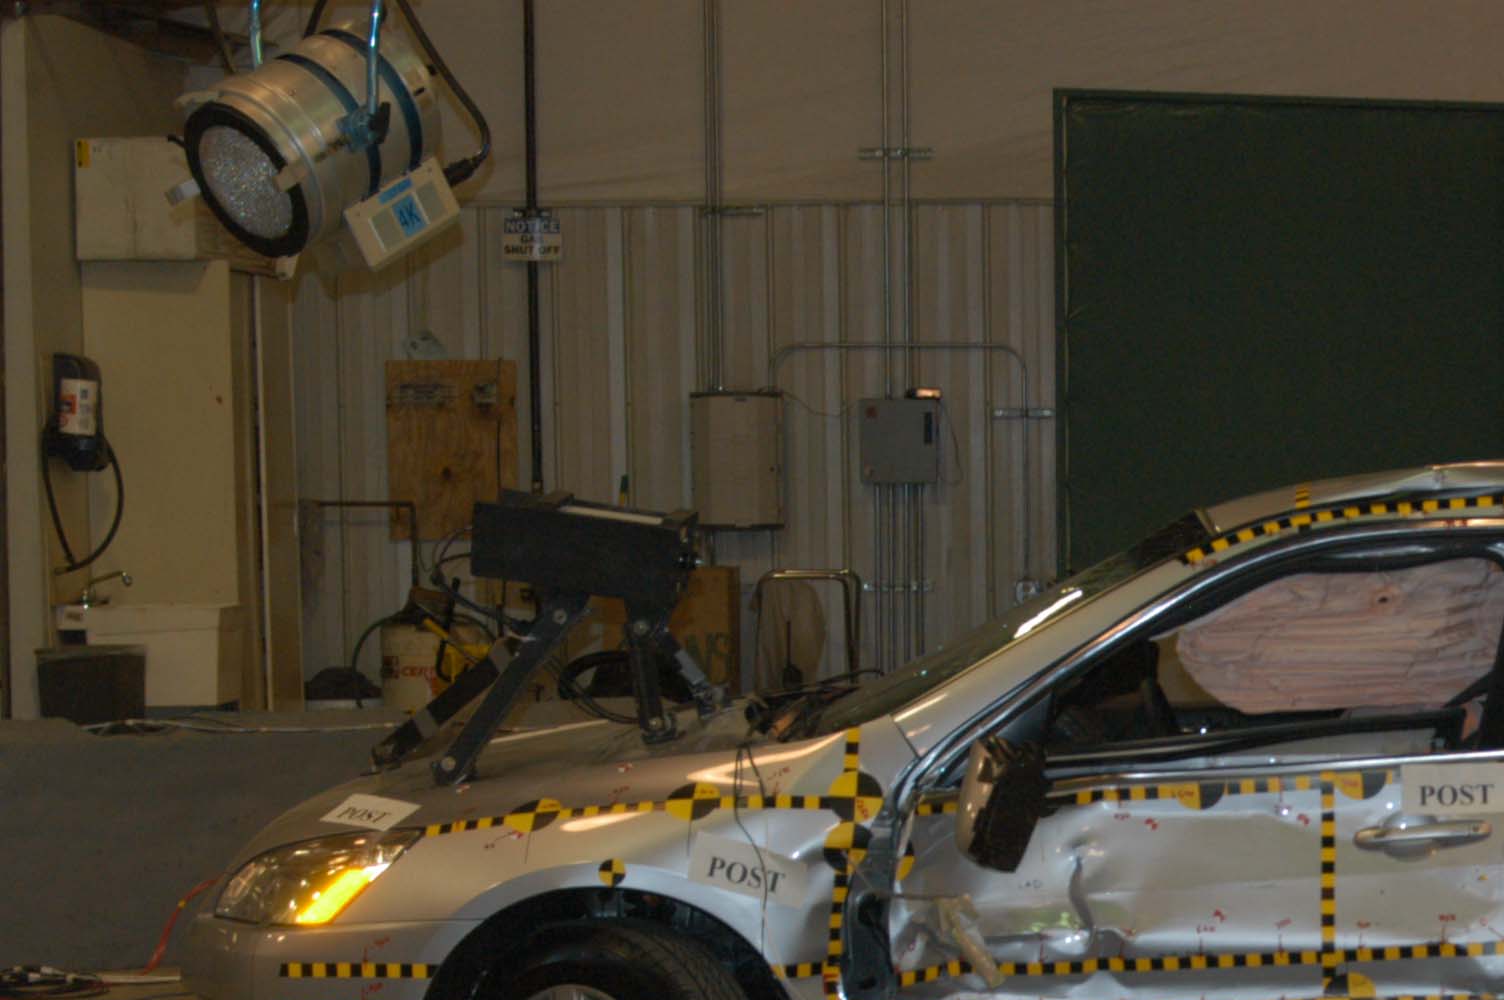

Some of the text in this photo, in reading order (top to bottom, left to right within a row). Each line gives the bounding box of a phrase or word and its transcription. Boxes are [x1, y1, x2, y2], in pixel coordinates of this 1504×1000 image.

[505, 218, 560, 232] NOTICE
[504, 245, 535, 256] SHUT
[1418, 783, 1496, 806] POST
[335, 806, 392, 823] POST
[707, 856, 787, 893] POST
